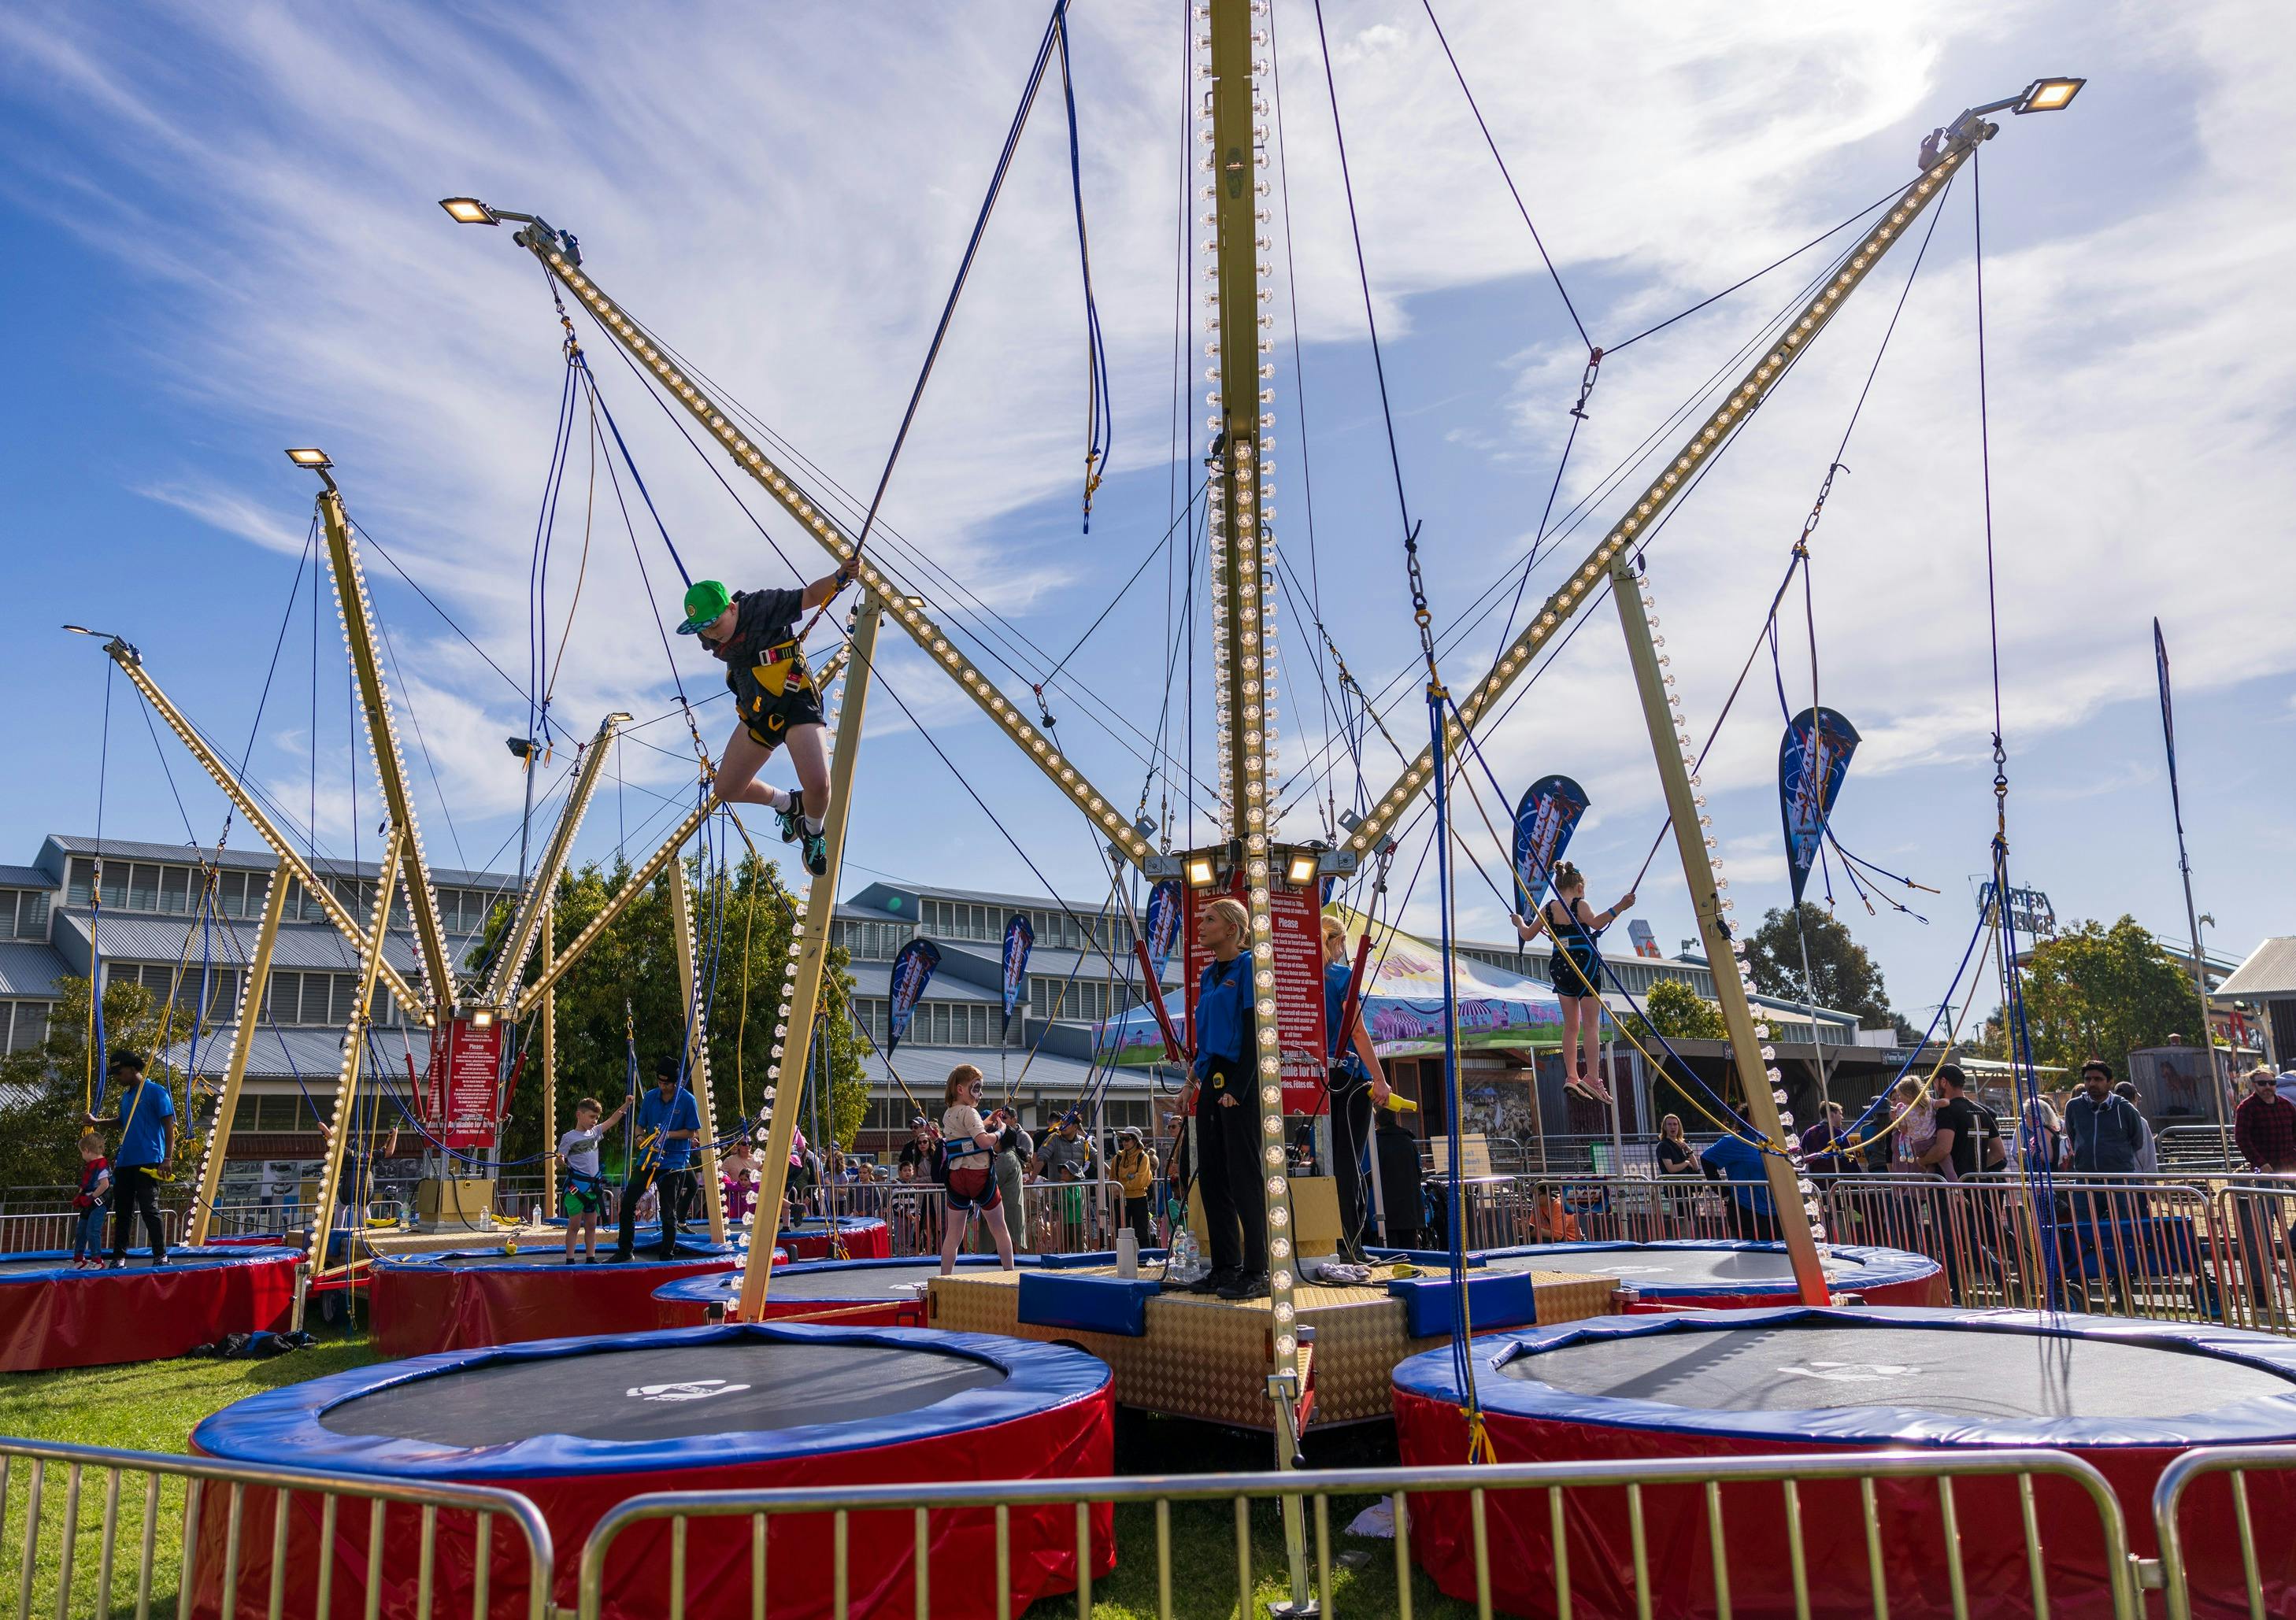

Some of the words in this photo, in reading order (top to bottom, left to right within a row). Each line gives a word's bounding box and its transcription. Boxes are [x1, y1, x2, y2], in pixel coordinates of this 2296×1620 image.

[1805, 742, 1831, 822] BGEE
[1531, 793, 1552, 843] HIGH
[1279, 917, 1298, 929] Please
[1986, 903, 2053, 935] REENGE
[1299, 1064, 1309, 1077] for
